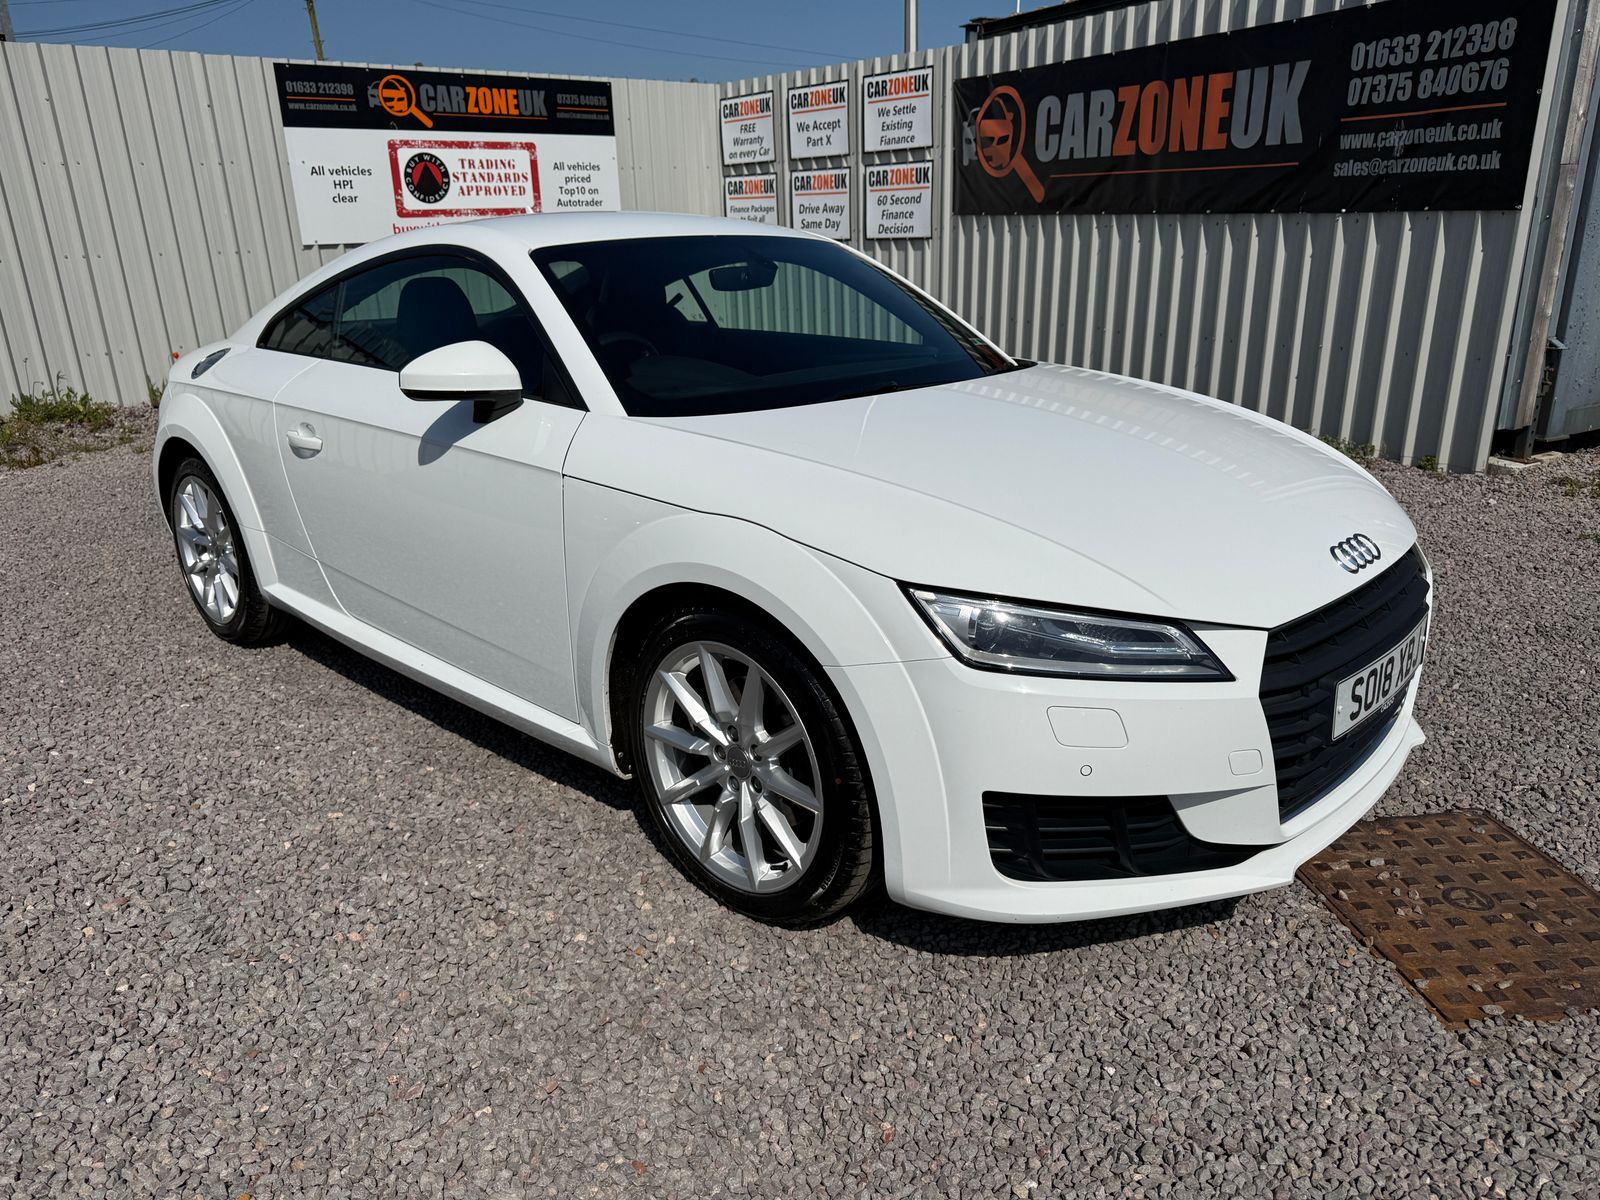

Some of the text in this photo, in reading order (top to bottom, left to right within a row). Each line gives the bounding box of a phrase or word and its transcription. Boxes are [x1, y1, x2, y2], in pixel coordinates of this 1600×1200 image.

[1350, 17, 1517, 71] 01633 212398
[285, 81, 354, 95] 01633 212398
[867, 73, 929, 99] CARZONEUK
[1347, 57, 1510, 106] 07375 840676
[419, 83, 548, 116] CARZONEUK
[791, 86, 846, 110] CARZONEUK
[723, 97, 771, 119] CARZONEUK
[877, 103, 917, 118] We Settle
[1035, 60, 1311, 162] CARZONEUK
[740, 123, 756, 134] FREE
[796, 118, 841, 133] We Accept
[881, 119, 913, 133] Existing
[733, 135, 764, 147] Warranty
[806, 134, 832, 147] Part X
[879, 134, 915, 146] Fianance
[1340, 118, 1503, 150] www.carzoneuk.co.uk
[738, 150, 758, 161] every
[758, 147, 770, 156] Car
[310, 165, 372, 176] All vehicles
[406, 156, 420, 173] BUY
[423, 154, 446, 173] WITH
[458, 158, 516, 170] TRADING
[553, 162, 600, 171] All vehicles
[1333, 150, 1502, 177] sales@carzoneuk.co.uk
[452, 171, 529, 183] STANDARDS
[565, 174, 591, 186] priced
[793, 172, 847, 192] CARZONEUK
[868, 167, 930, 187] CARZONEUK
[333, 180, 353, 189] HPI
[406, 177, 449, 203] CONFIDENCE
[458, 185, 526, 196] APPROVED
[559, 186, 586, 197] Top10
[727, 176, 775, 196] CARZONEUK
[332, 193, 359, 203] clear
[557, 198, 603, 207] Autotrader
[877, 193, 922, 206] 60 Second
[730, 204, 775, 214] Finance Packages
[798, 203, 845, 216] Drive Away
[881, 209, 914, 220] Finance
[801, 218, 841, 231] Same Day
[878, 223, 914, 235] Decision
[1349, 656, 1395, 721] SO18
